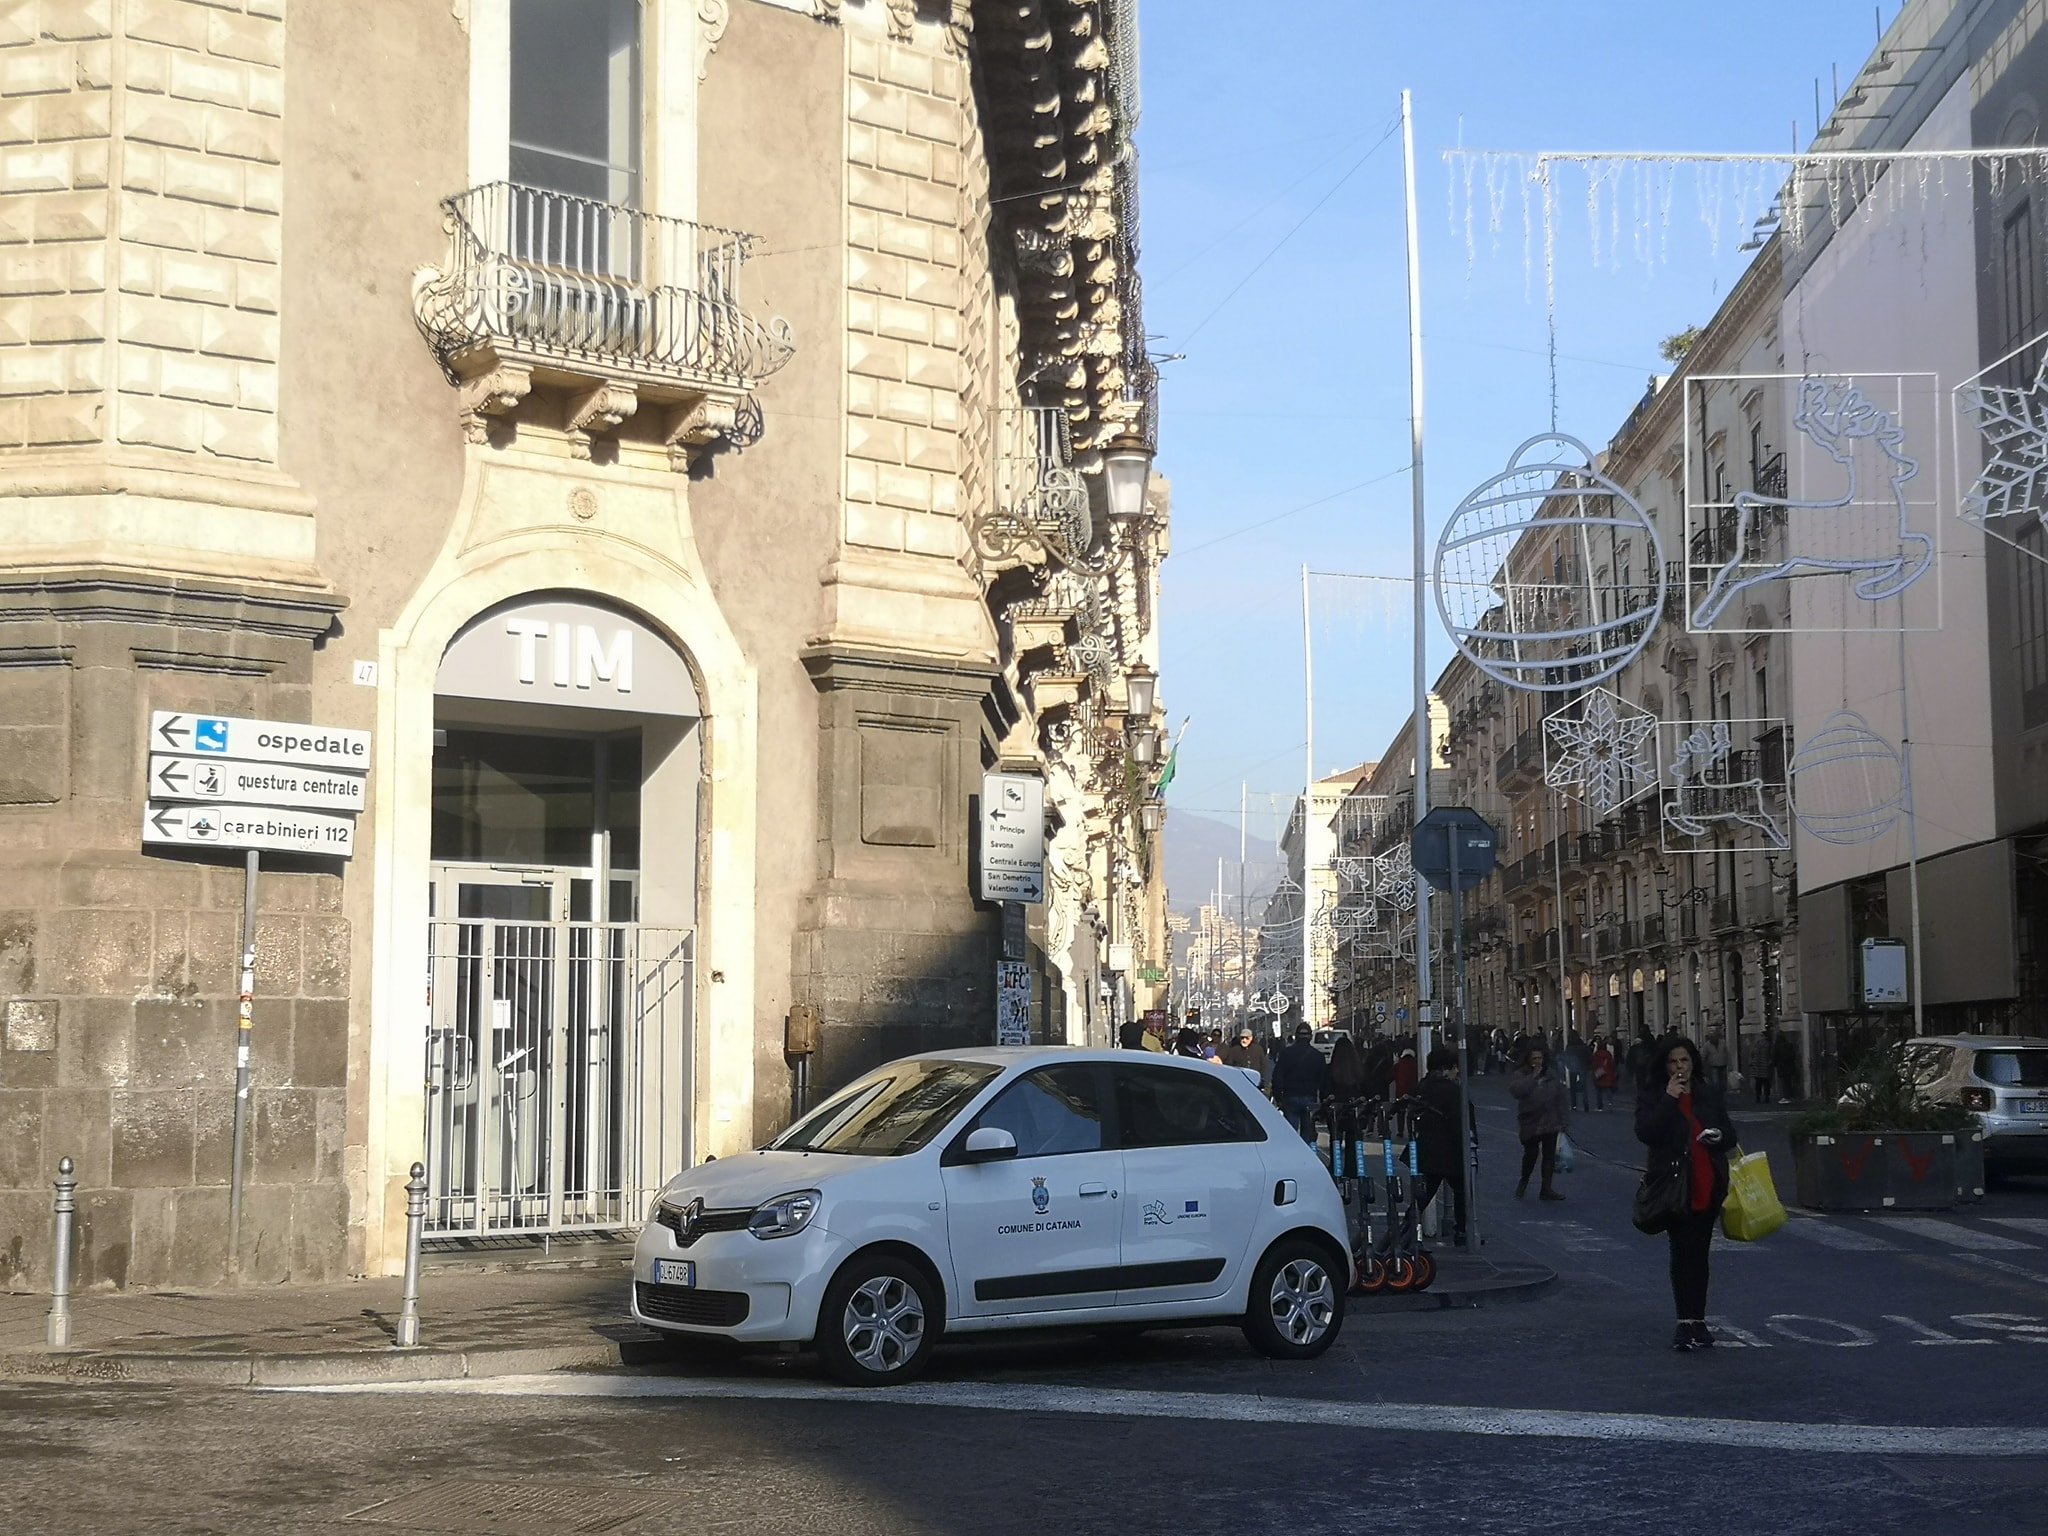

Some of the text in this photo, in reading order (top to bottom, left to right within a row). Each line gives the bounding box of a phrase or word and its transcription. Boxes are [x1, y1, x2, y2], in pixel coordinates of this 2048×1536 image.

[506, 618, 633, 693] TIM
[357, 665, 373, 682] 47
[257, 731, 365, 756] ospedale
[237, 773, 359, 797] questura centrale
[223, 820, 348, 843] carabinieri 112
[999, 825, 1026, 835] Principe
[990, 841, 1014, 849] Savona
[990, 857, 1041, 868] Centrale Europa
[988, 872, 1032, 883] San Demetrio
[988, 884, 1019, 893] Valentino
[998, 1220, 1081, 1235] COMUNE DI CATANIA
